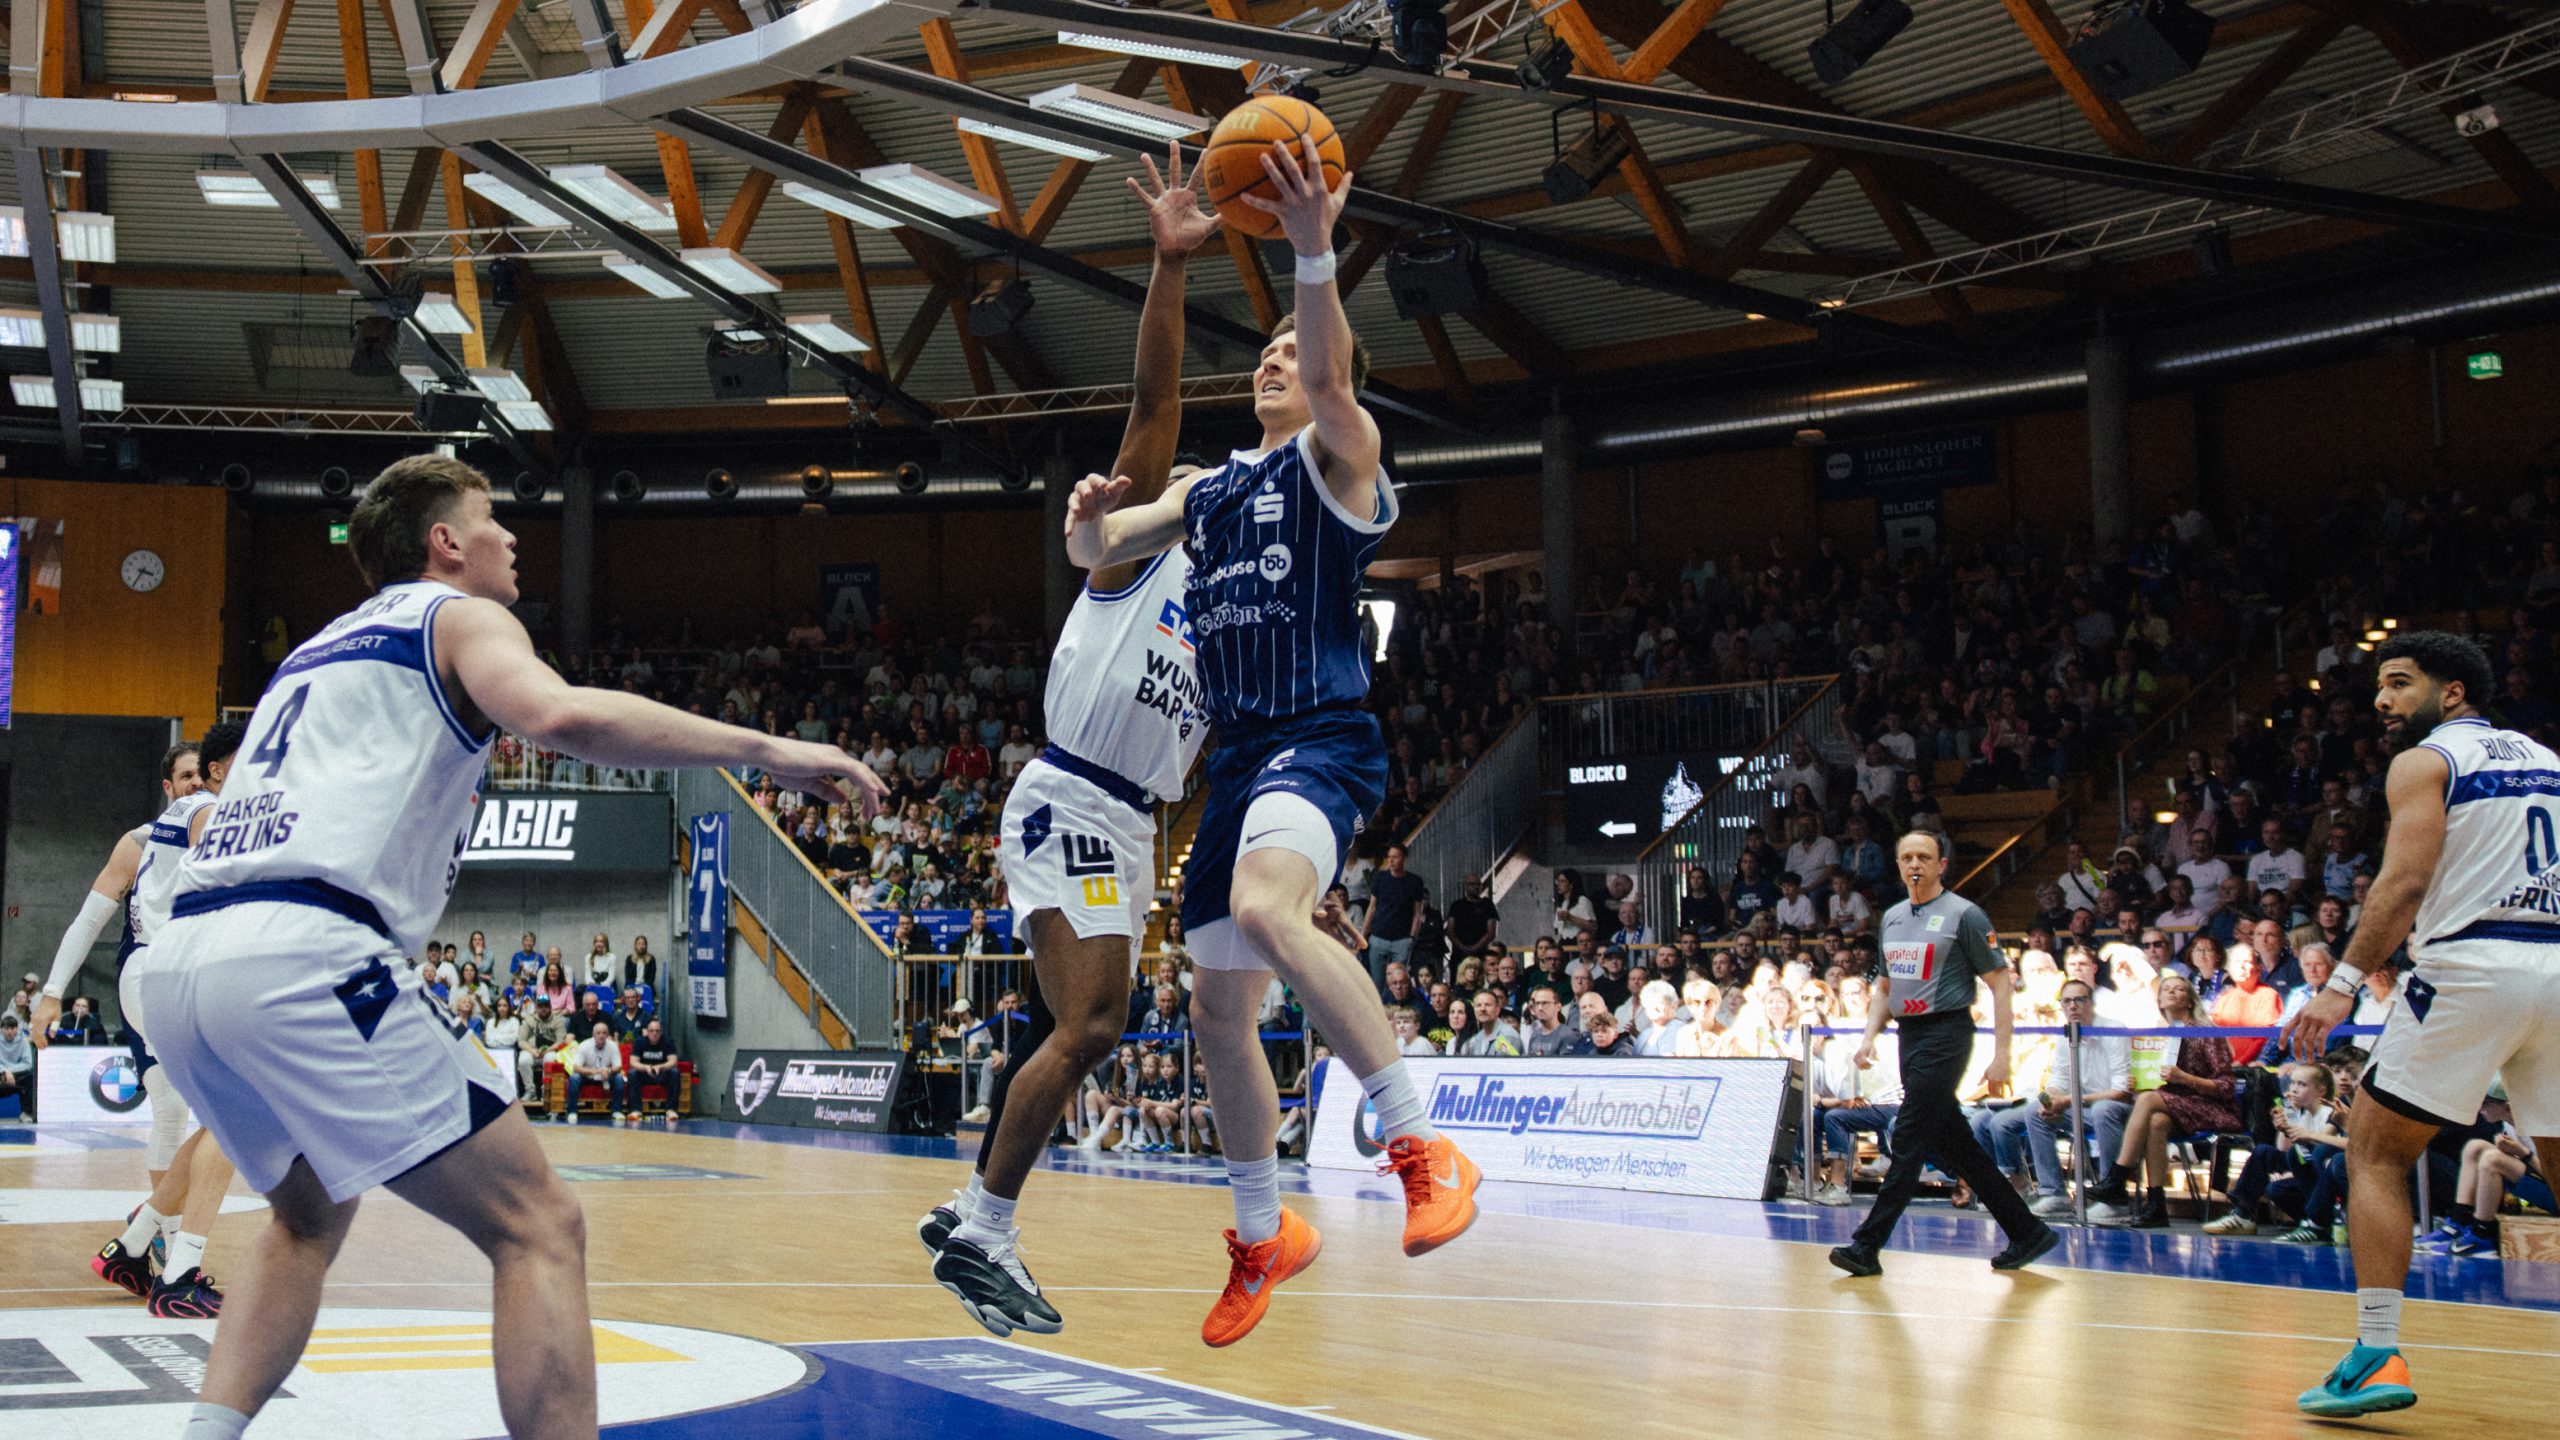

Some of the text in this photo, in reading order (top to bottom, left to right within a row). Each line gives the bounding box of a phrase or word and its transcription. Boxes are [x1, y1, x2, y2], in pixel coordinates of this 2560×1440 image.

[1863, 437, 1983, 462] HOHENLOHER
[1865, 455, 1945, 476] TAGBLATT
[1882, 499, 1936, 516] BLOCK
[826, 572, 873, 584] BLOCK
[825, 586, 873, 632] A
[1134, 676, 1183, 720] BAR
[248, 682, 311, 779] 4
[2478, 738, 2536, 761] BLUNT
[1569, 766, 1615, 784] BLOCK
[2503, 775, 2560, 788] SCHUBER
[213, 791, 285, 825] HAKRO
[471, 799, 578, 848] AGIC
[699, 869, 714, 933] 7
[1523, 1144, 1547, 1168] Wir
[1547, 1145, 1609, 1178] bewegen
